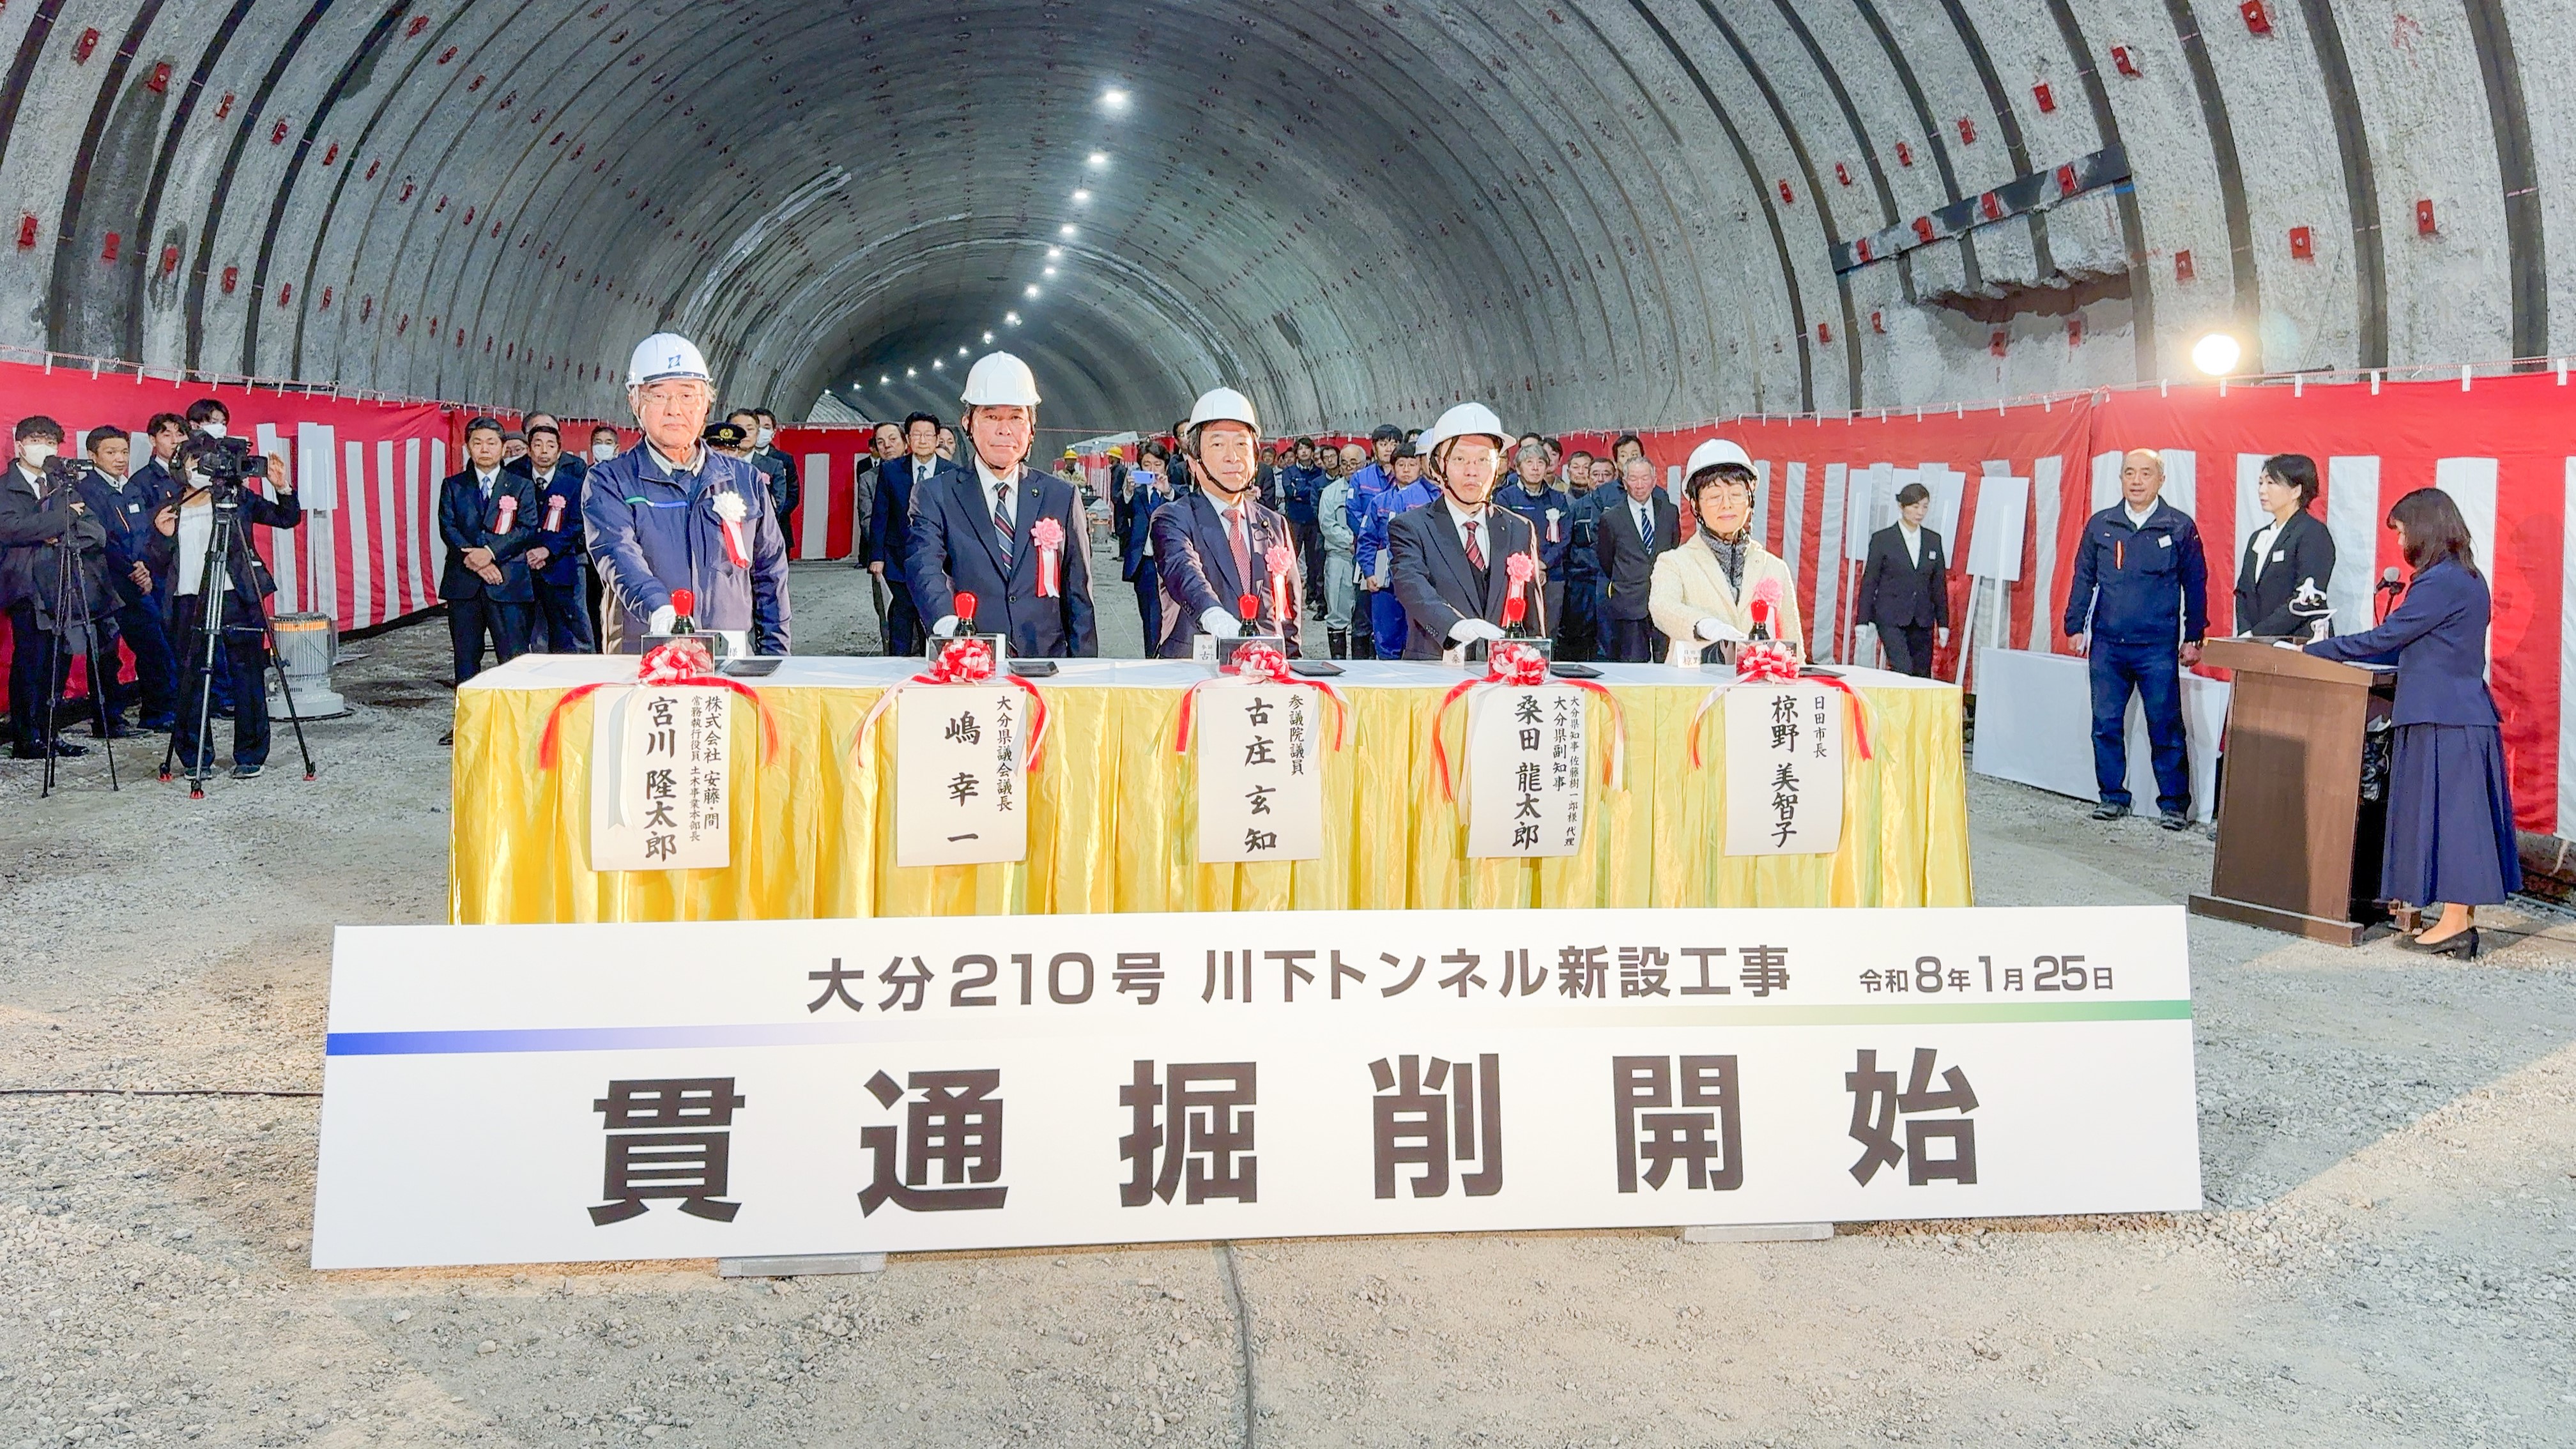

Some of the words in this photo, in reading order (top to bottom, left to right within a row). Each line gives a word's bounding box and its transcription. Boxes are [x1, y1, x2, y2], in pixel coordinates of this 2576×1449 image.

[646, 696, 678, 758] 宮川
[691, 695, 703, 762] 常務執行役員
[703, 695, 723, 764] 株式会社
[997, 695, 1013, 812] 大分県議会議長
[1245, 696, 1276, 767] 古庄
[1288, 694, 1305, 776] 参議院議員
[1514, 694, 1544, 751] 桑田
[1552, 696, 1568, 792] 大分県副知事
[1570, 696, 1580, 753] 大分県知事
[1771, 694, 1800, 753] 椋野
[1813, 696, 1827, 758] 日田市長
[643, 769, 678, 862] 隆太郎
[689, 766, 702, 842] 土木事業本部長
[703, 770, 721, 830] 安藤・間
[1244, 785, 1277, 854] 玄知
[1512, 762, 1542, 851] 龍太郎
[1567, 755, 1580, 823] 佐藤樹一郎様
[1770, 762, 1800, 848] 美智子
[1564, 825, 1576, 847] 代理
[806, 951, 1165, 1014] 大分210号
[1200, 944, 1790, 1004] 川下トンネル新設工事
[1859, 954, 2114, 993] 令和8年1月25日
[586, 1047, 1981, 1226] 貫通掘削開始
